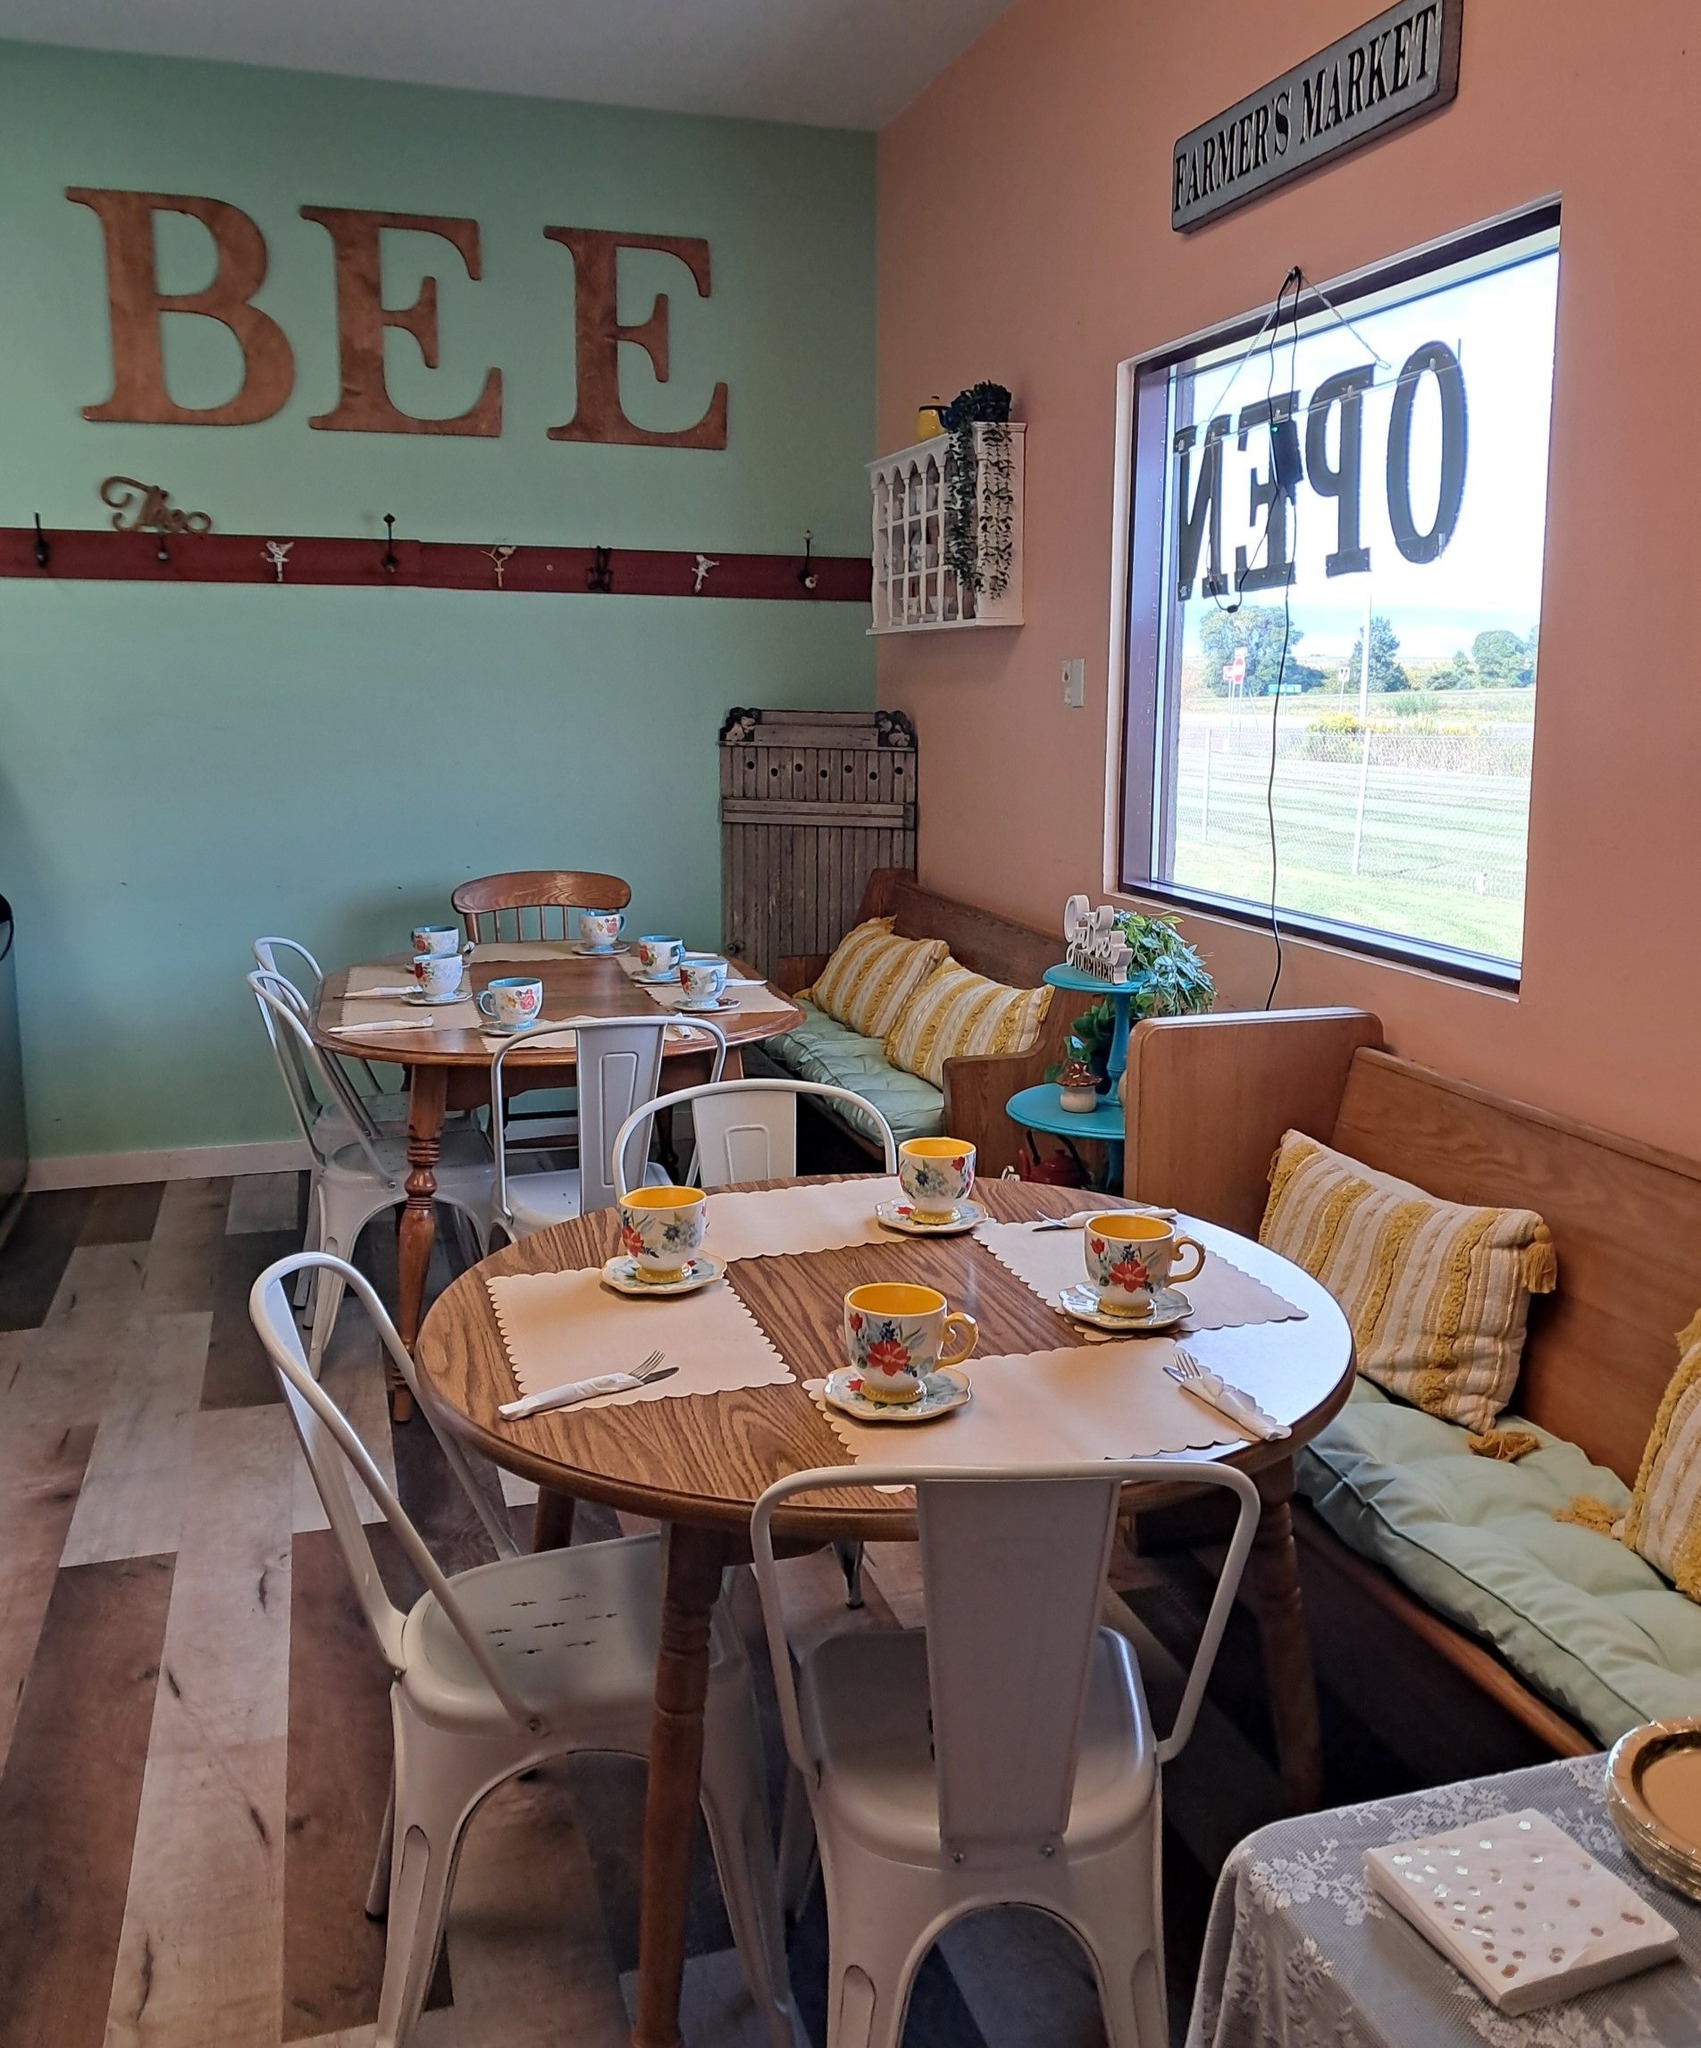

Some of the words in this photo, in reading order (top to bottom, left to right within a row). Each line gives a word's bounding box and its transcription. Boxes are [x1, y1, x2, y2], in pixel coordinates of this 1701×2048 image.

[1173, 87, 1292, 213] FARMER'S
[1299, 2, 1438, 144] MARKET
[65, 186, 729, 450] BEE
[1073, 951, 1116, 984] TOGETHER
